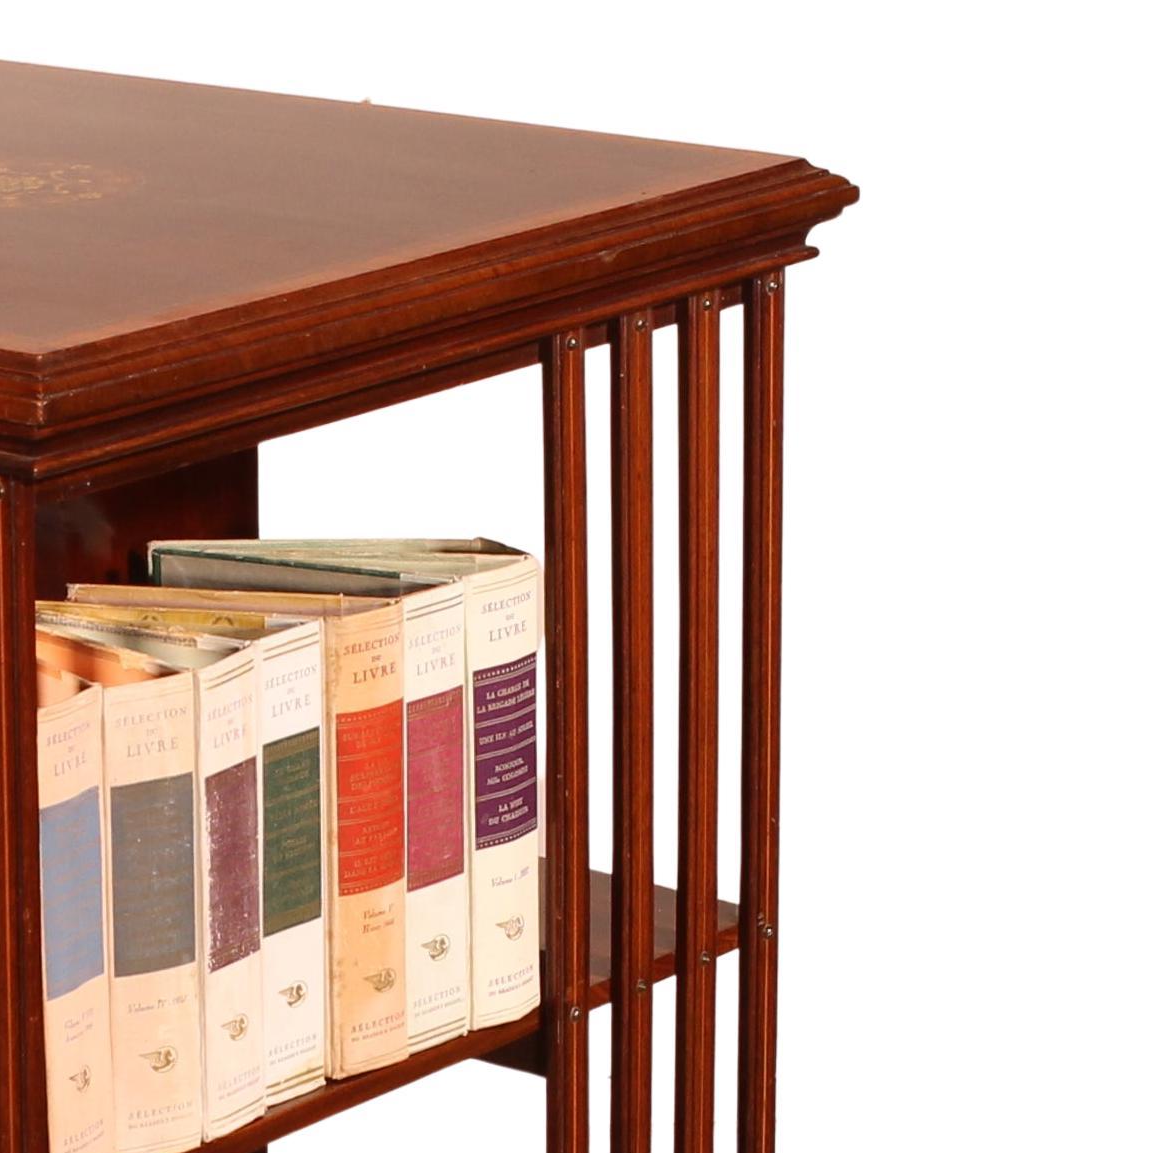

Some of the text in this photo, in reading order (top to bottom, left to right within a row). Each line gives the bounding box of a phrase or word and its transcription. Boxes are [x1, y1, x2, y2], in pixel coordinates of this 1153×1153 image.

[481, 591, 532, 614] SÉLECTION
[489, 620, 528, 642] LIVRE
[343, 632, 400, 656] SÉLECTION
[353, 661, 396, 685] LIVRE
[417, 654, 456, 676] LIVRE
[115, 706, 188, 728] SÉLECTION
[271, 694, 311, 719] LIVRE
[127, 737, 179, 758] LIVRE
